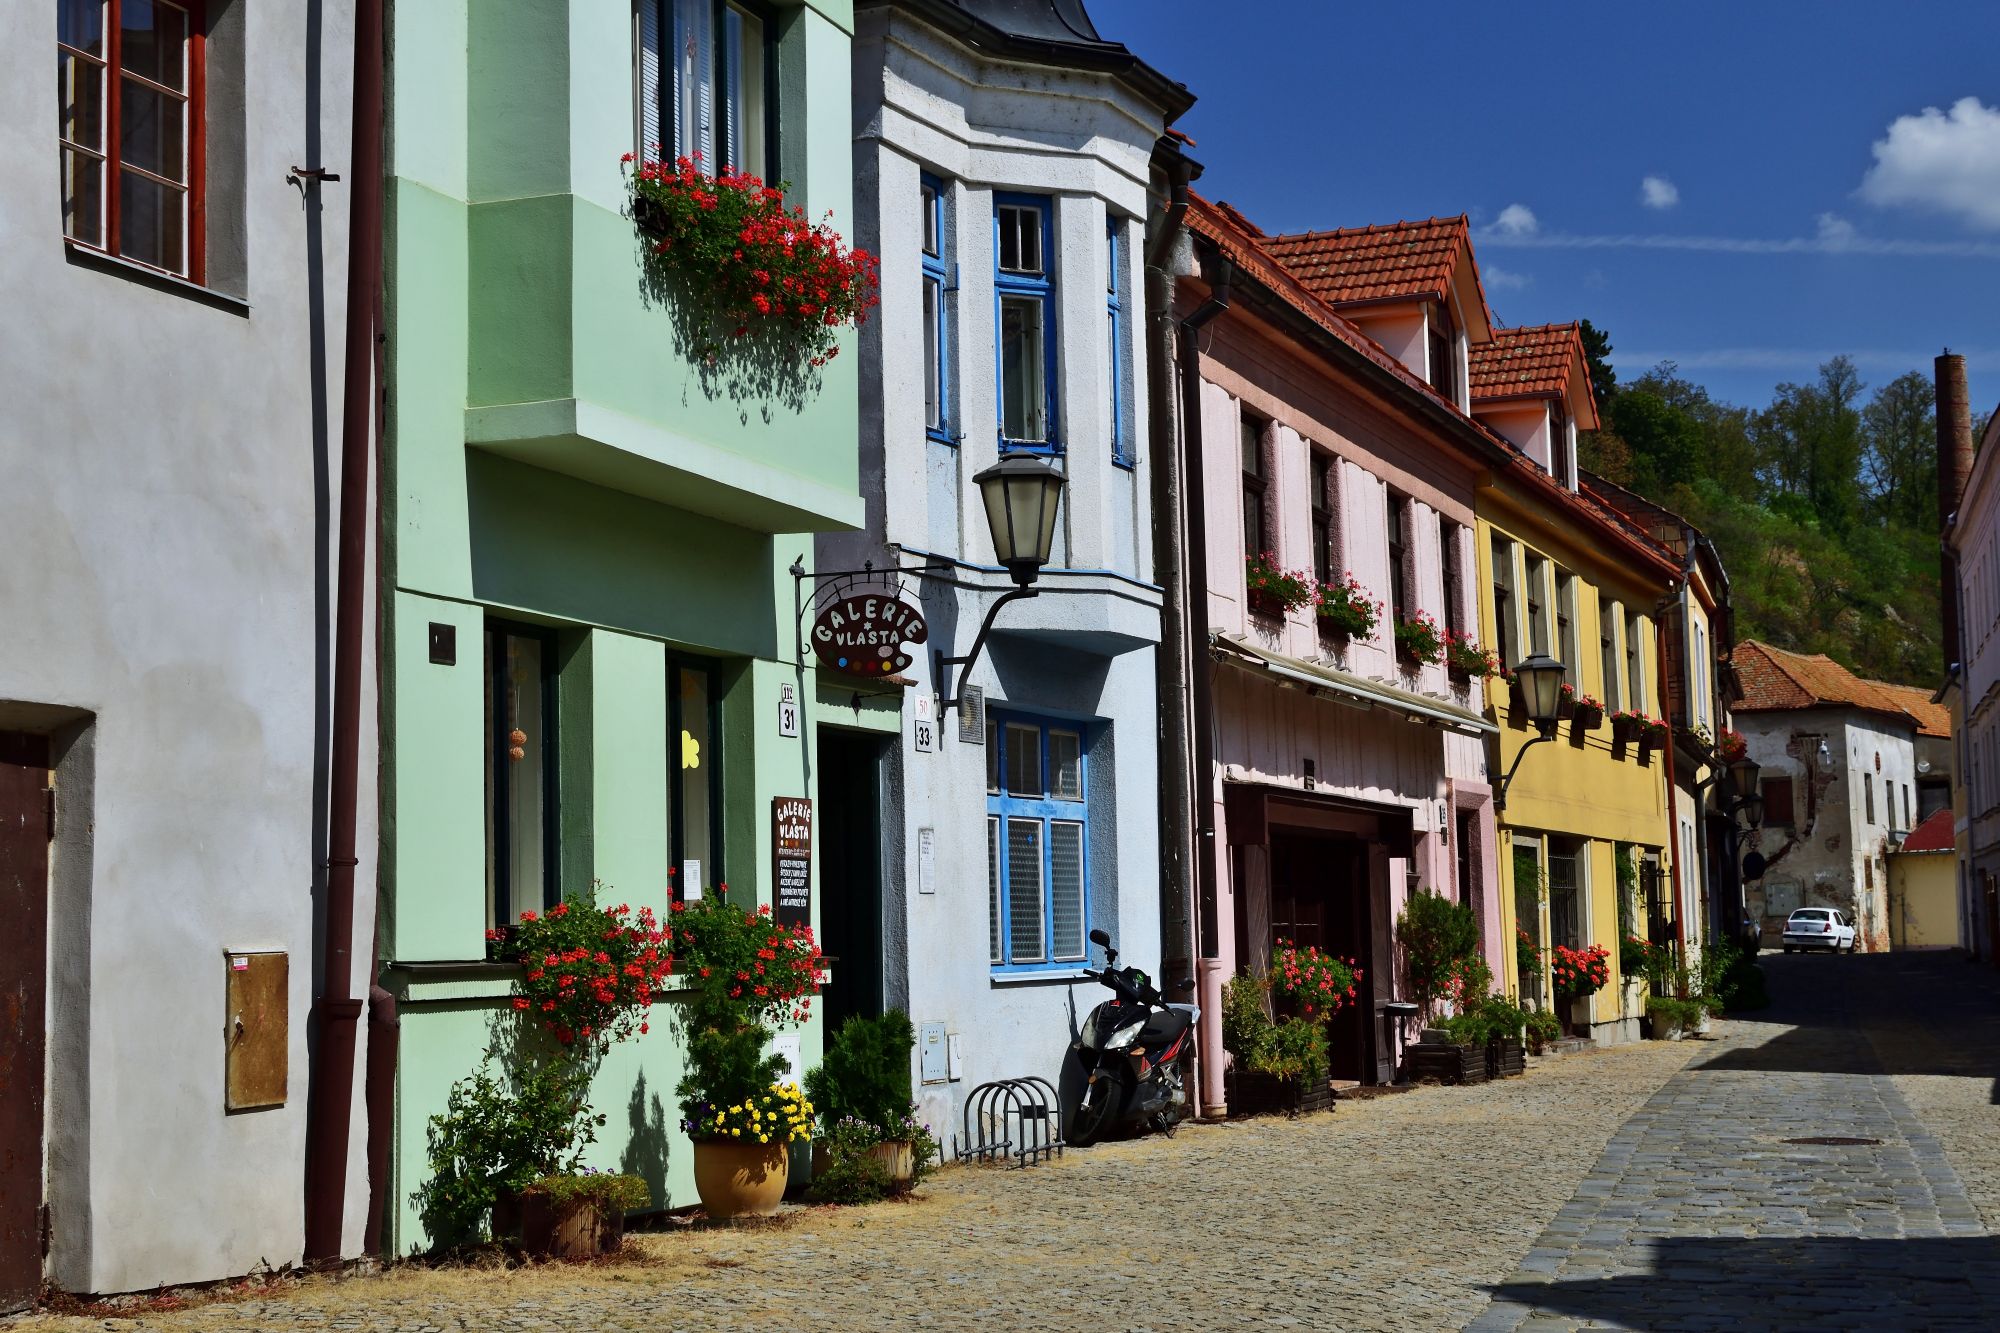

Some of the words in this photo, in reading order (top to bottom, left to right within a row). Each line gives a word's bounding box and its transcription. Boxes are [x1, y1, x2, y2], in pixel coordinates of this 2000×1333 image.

[836, 631, 899, 646] VLASTA
[919, 700, 928, 715] 50
[785, 709, 795, 731] 31
[919, 727, 930, 746] 33
[780, 825, 809, 840] VLASTA
